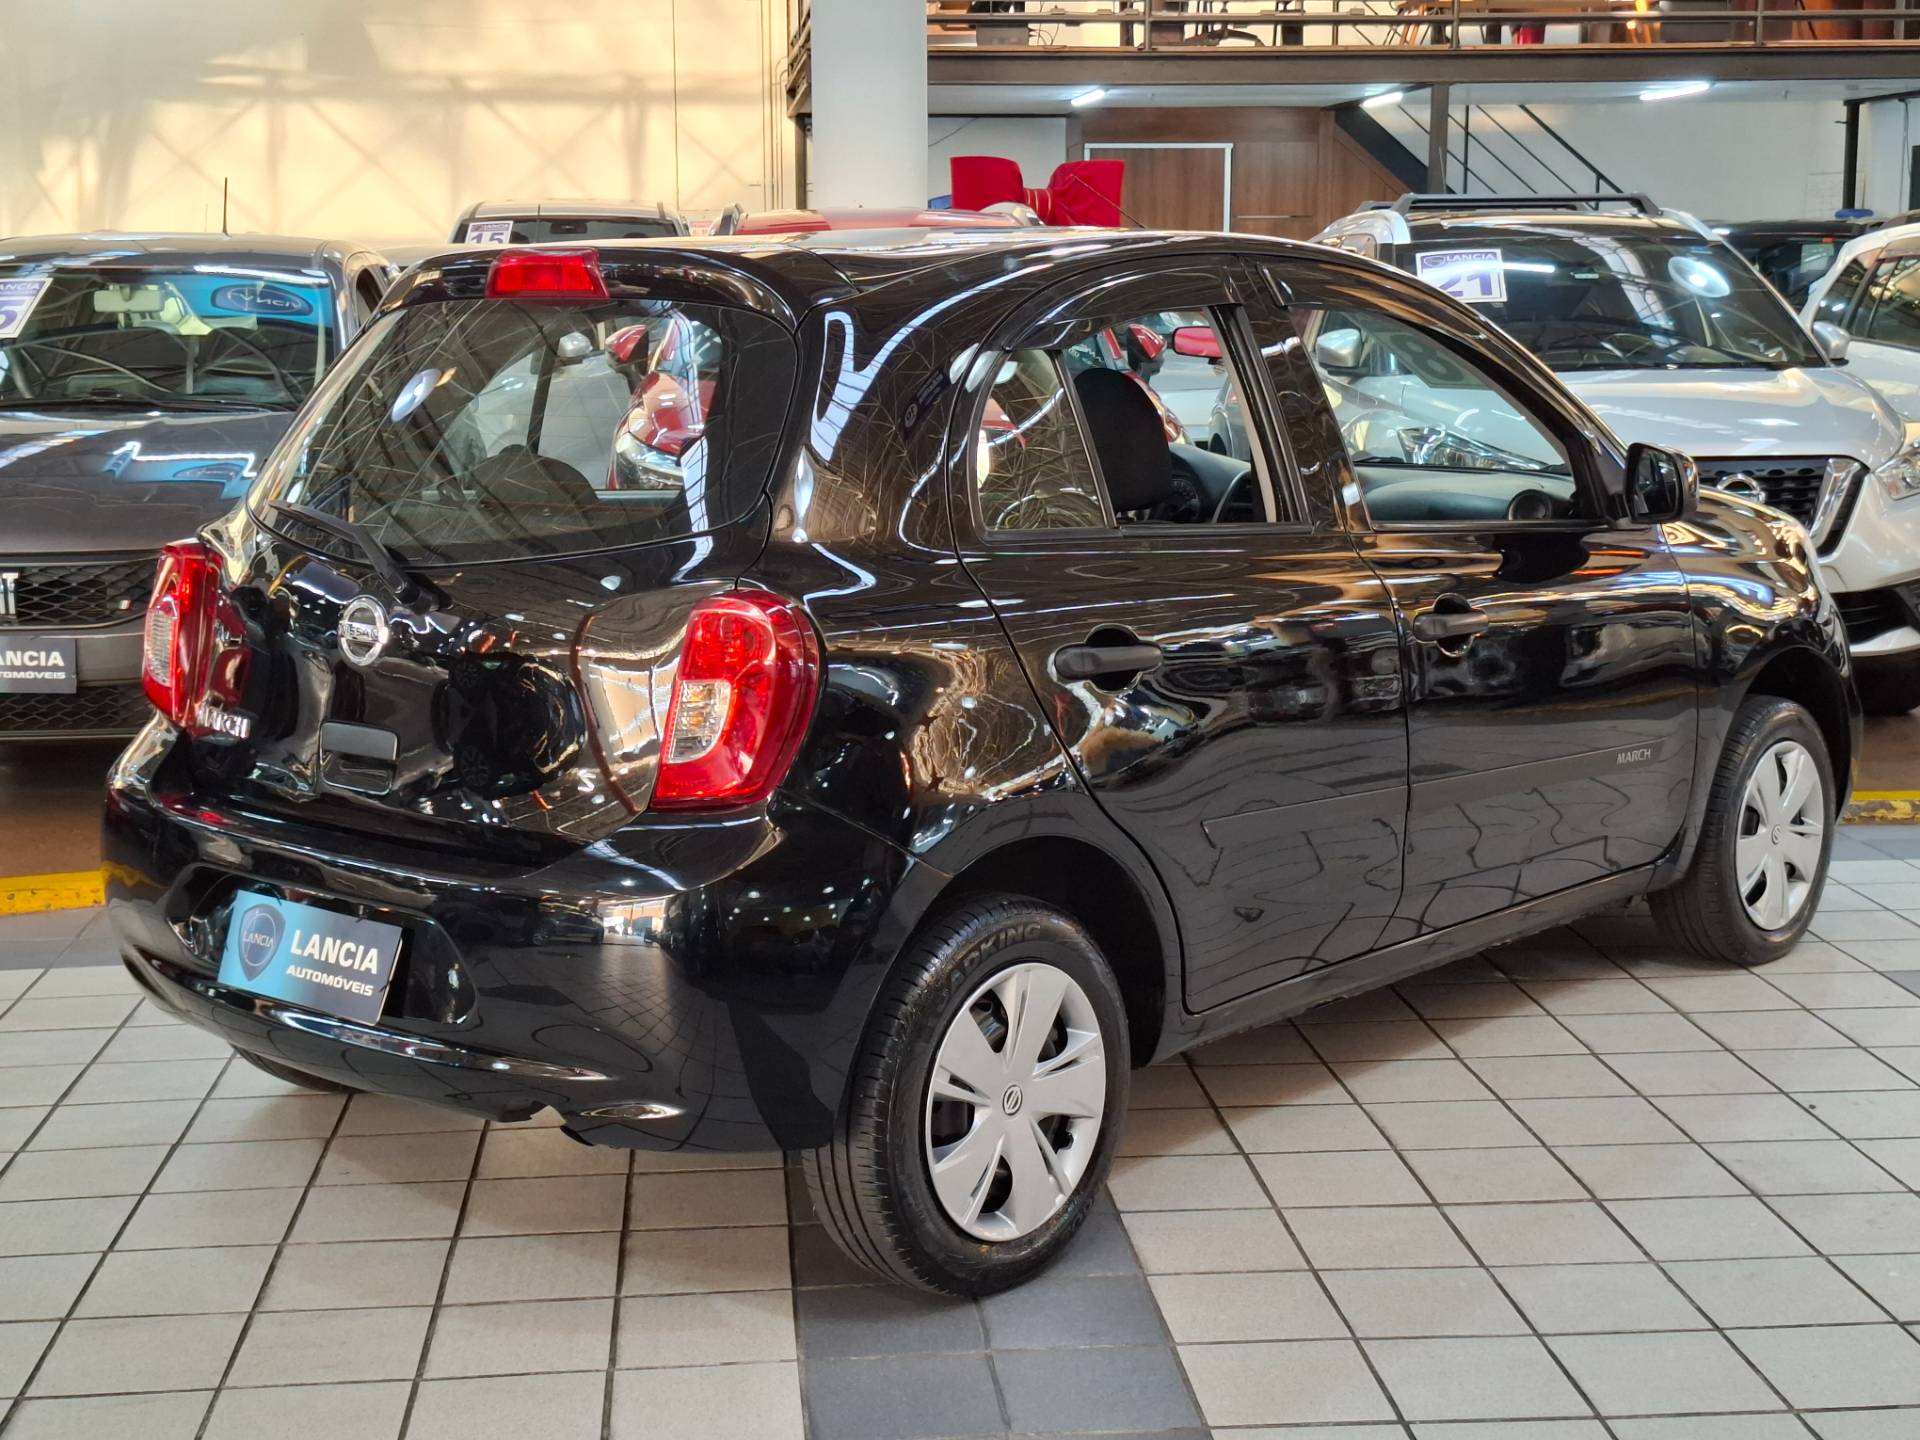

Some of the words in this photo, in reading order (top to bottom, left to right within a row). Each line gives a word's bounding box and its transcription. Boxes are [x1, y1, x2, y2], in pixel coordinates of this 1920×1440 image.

[1446, 253, 1496, 262] LANCIA
[1616, 748, 1651, 765] MARCH
[242, 930, 275, 947] LANCIA
[290, 929, 379, 975] LANCIA
[285, 964, 374, 997] AUTOMÓVEIS
